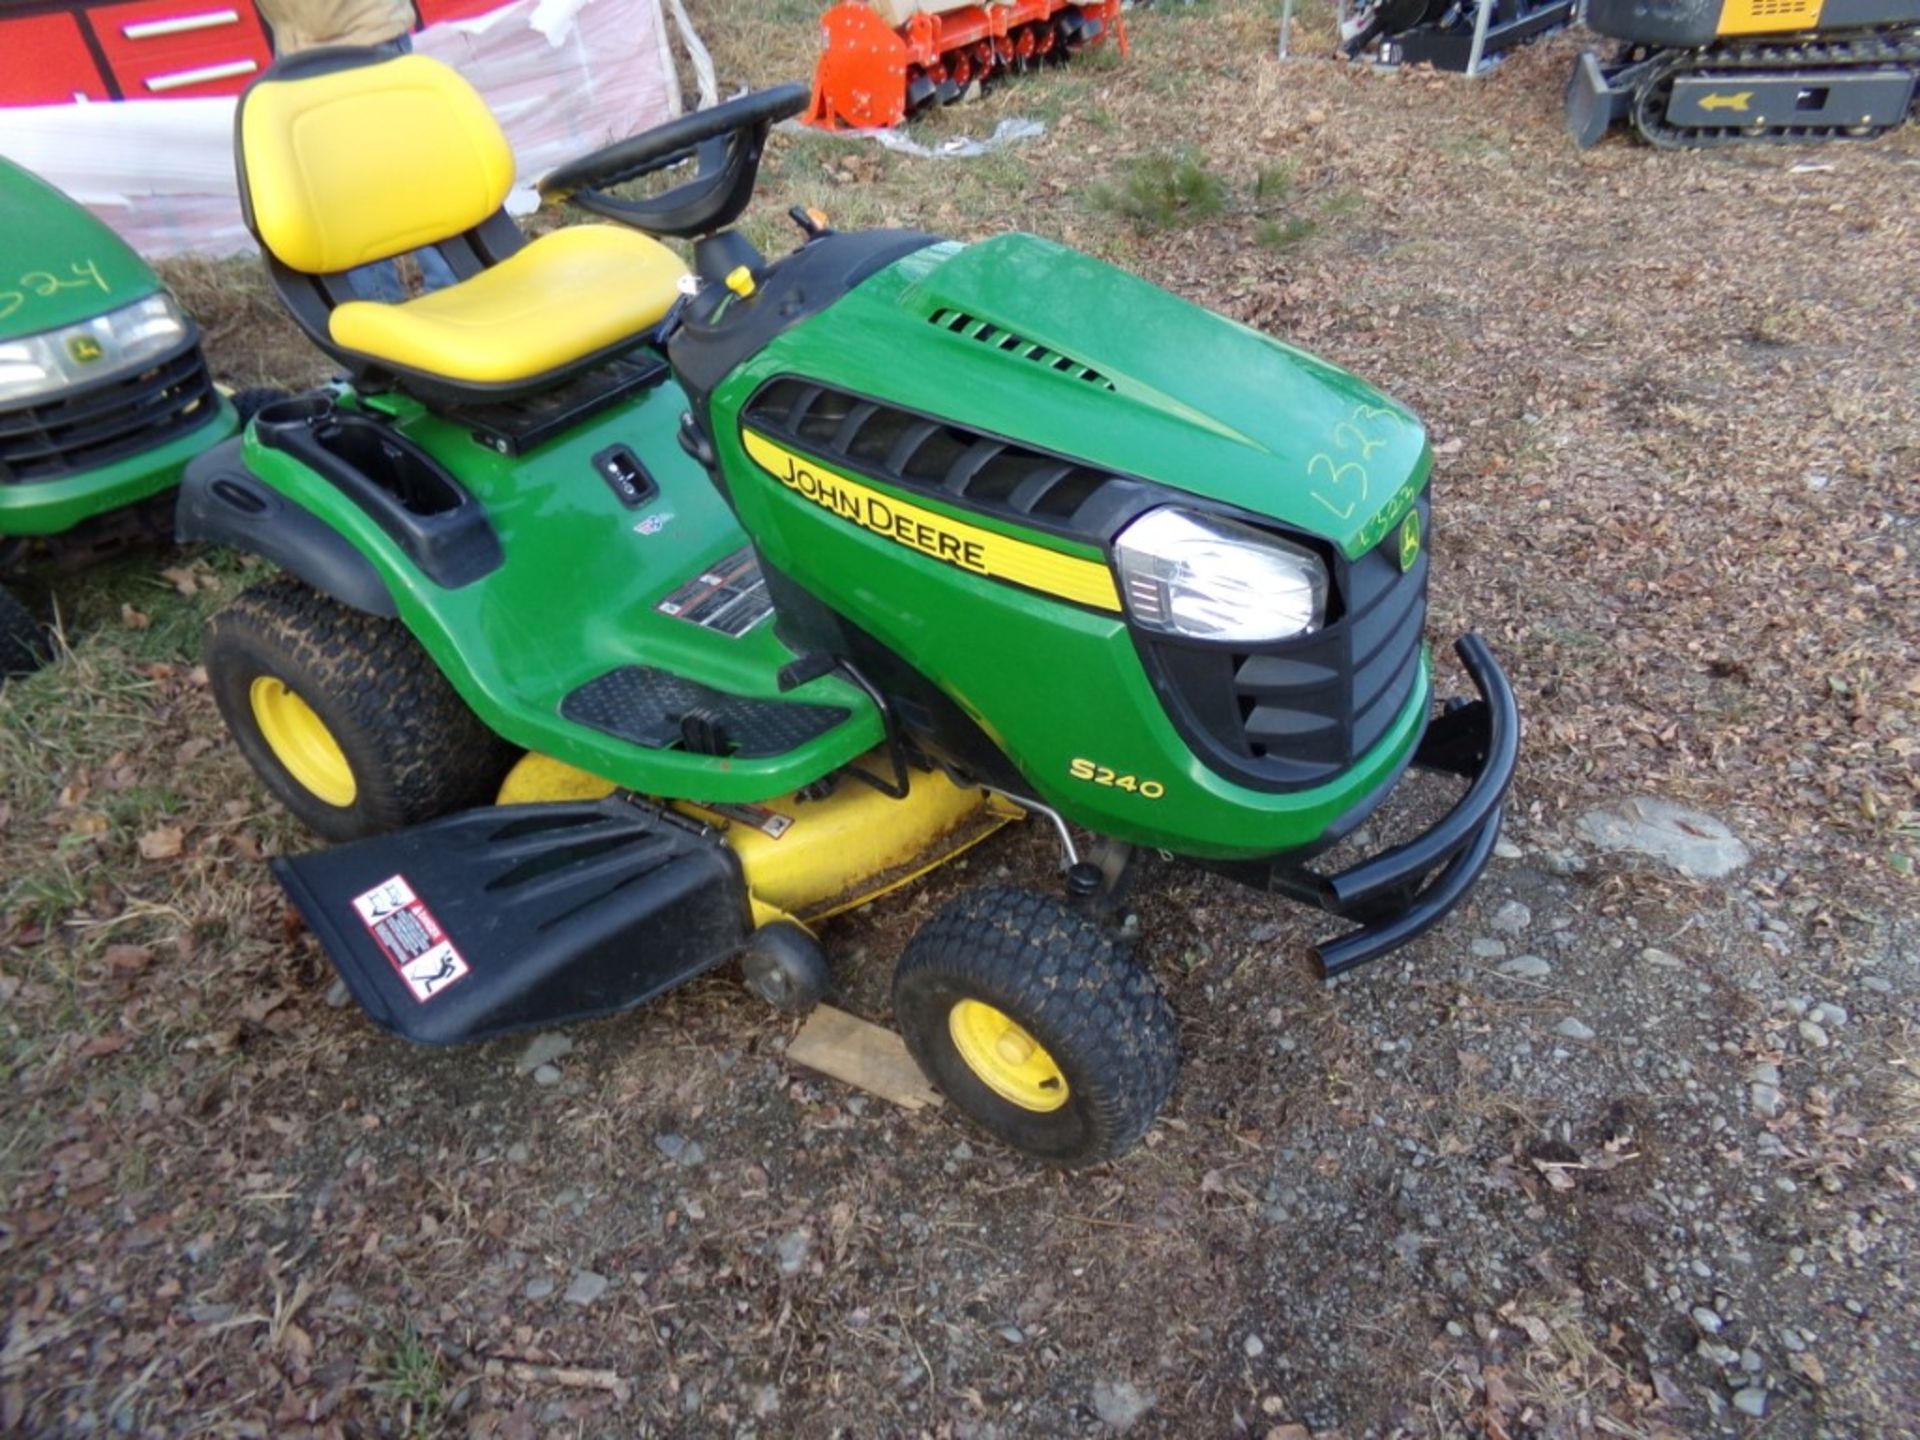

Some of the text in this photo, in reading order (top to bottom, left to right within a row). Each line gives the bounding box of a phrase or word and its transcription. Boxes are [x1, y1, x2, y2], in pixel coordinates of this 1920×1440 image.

[782, 458, 985, 569] JOHN DEERE
[1069, 757, 1165, 799] S240
